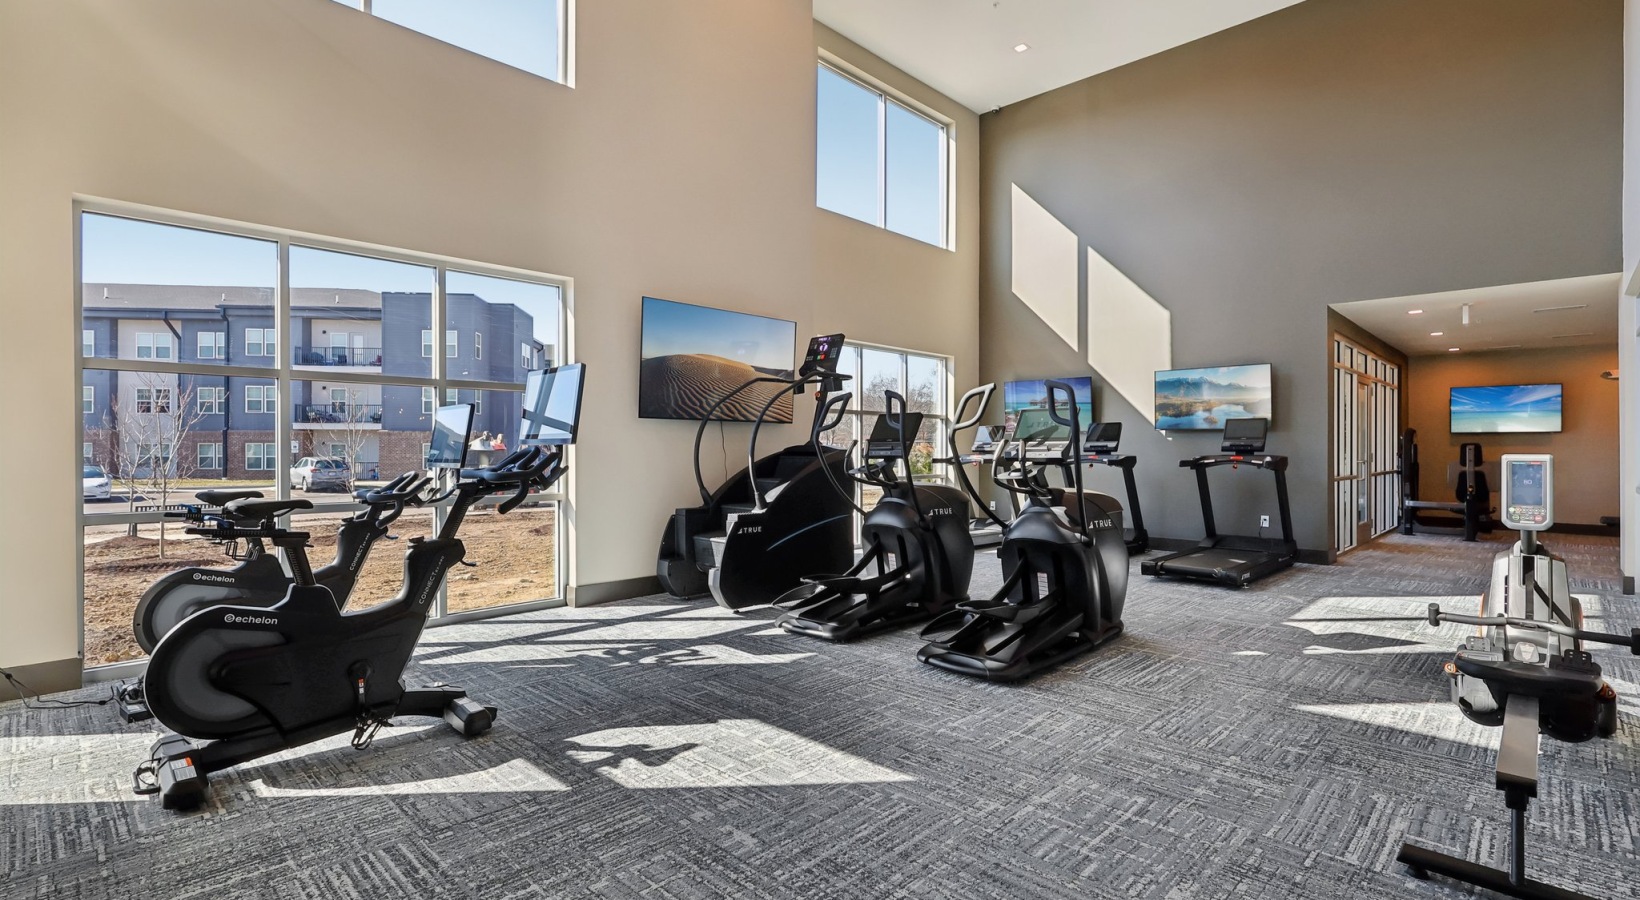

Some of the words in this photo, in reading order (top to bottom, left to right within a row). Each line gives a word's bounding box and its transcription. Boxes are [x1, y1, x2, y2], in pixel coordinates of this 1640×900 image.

[933, 507, 953, 515] TRUE
[1093, 519, 1112, 528] TRUE
[743, 526, 762, 534] TRUE
[349, 545, 364, 571] CONNECT
[201, 574, 235, 583] echelon
[418, 571, 437, 605] CONNECT
[235, 615, 278, 625] echelon
